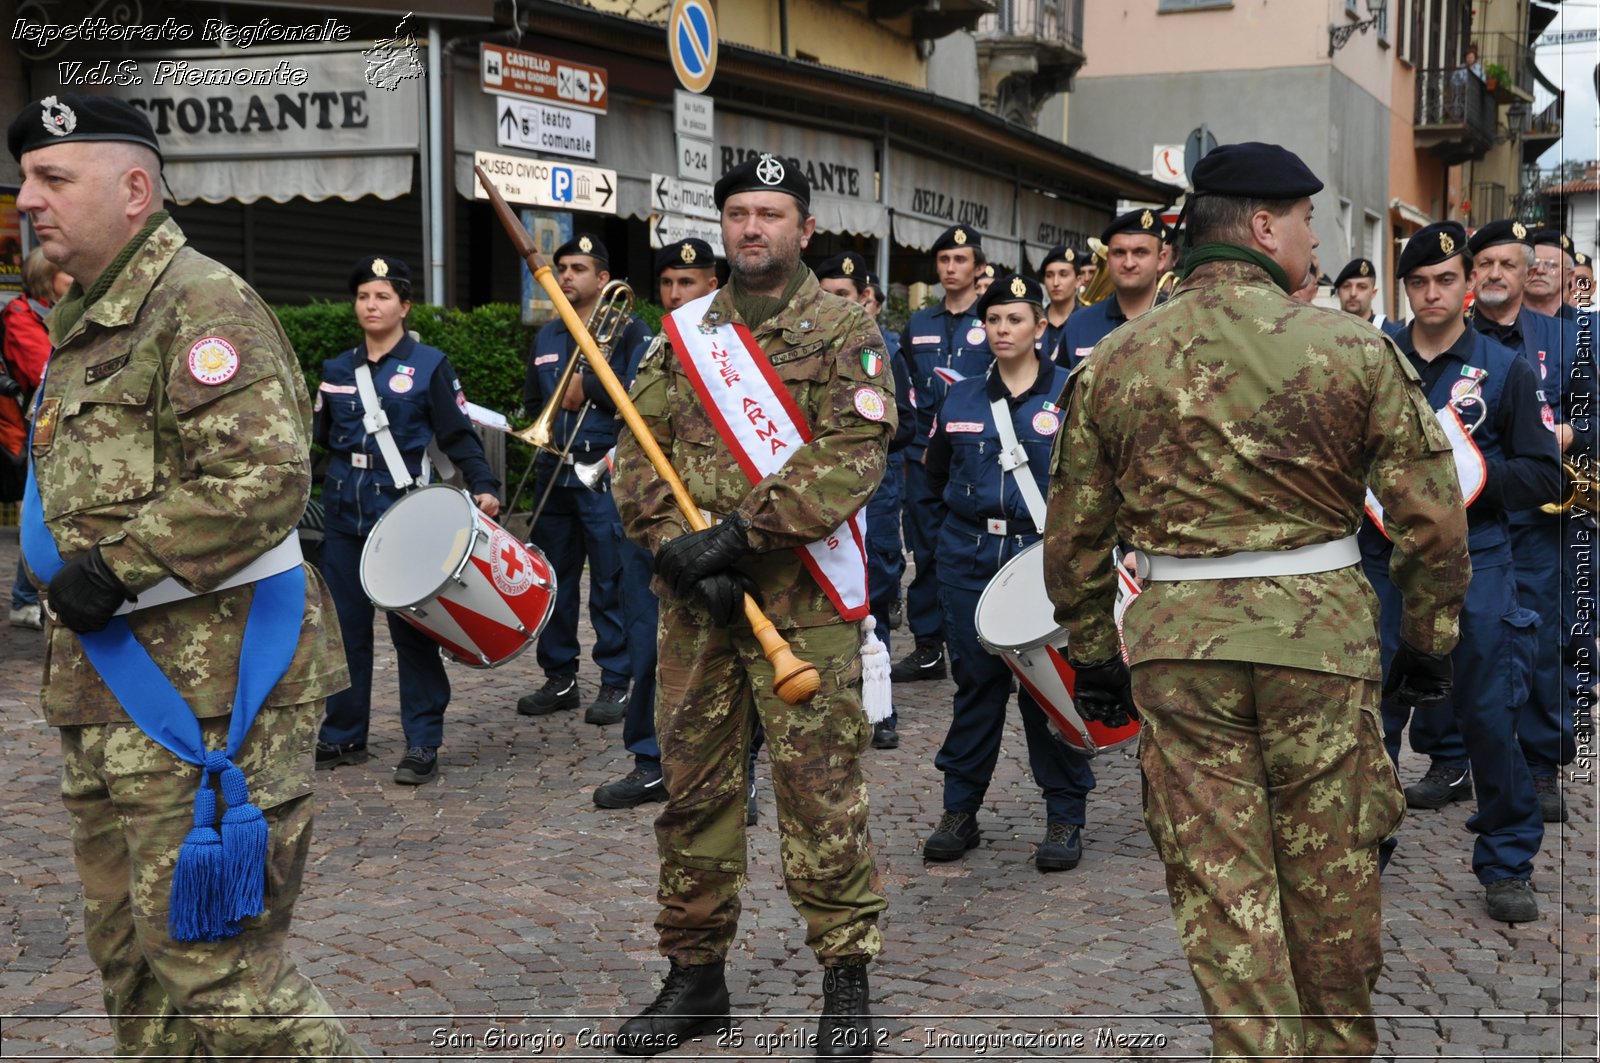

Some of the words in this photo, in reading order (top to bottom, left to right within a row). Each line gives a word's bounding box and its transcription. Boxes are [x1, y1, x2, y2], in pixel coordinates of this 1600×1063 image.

[506, 51, 551, 72] CASTELLO
[503, 67, 510, 76] di
[511, 68, 526, 80] SAN
[527, 70, 557, 86] GIORGIO
[542, 108, 571, 129] teatro
[542, 132, 591, 152] comunale
[685, 148, 707, 169] 0-24
[480, 158, 514, 176] MUSEO
[516, 163, 549, 181] CIVICO
[912, 187, 954, 221] DELLA
[957, 200, 988, 230] LUNA
[195, 339, 212, 350] ROSSA
[864, 348, 882, 360] ITALIA
[201, 365, 235, 382] FANFARA
[711, 341, 741, 388] INTER
[743, 397, 788, 456] ARMA
